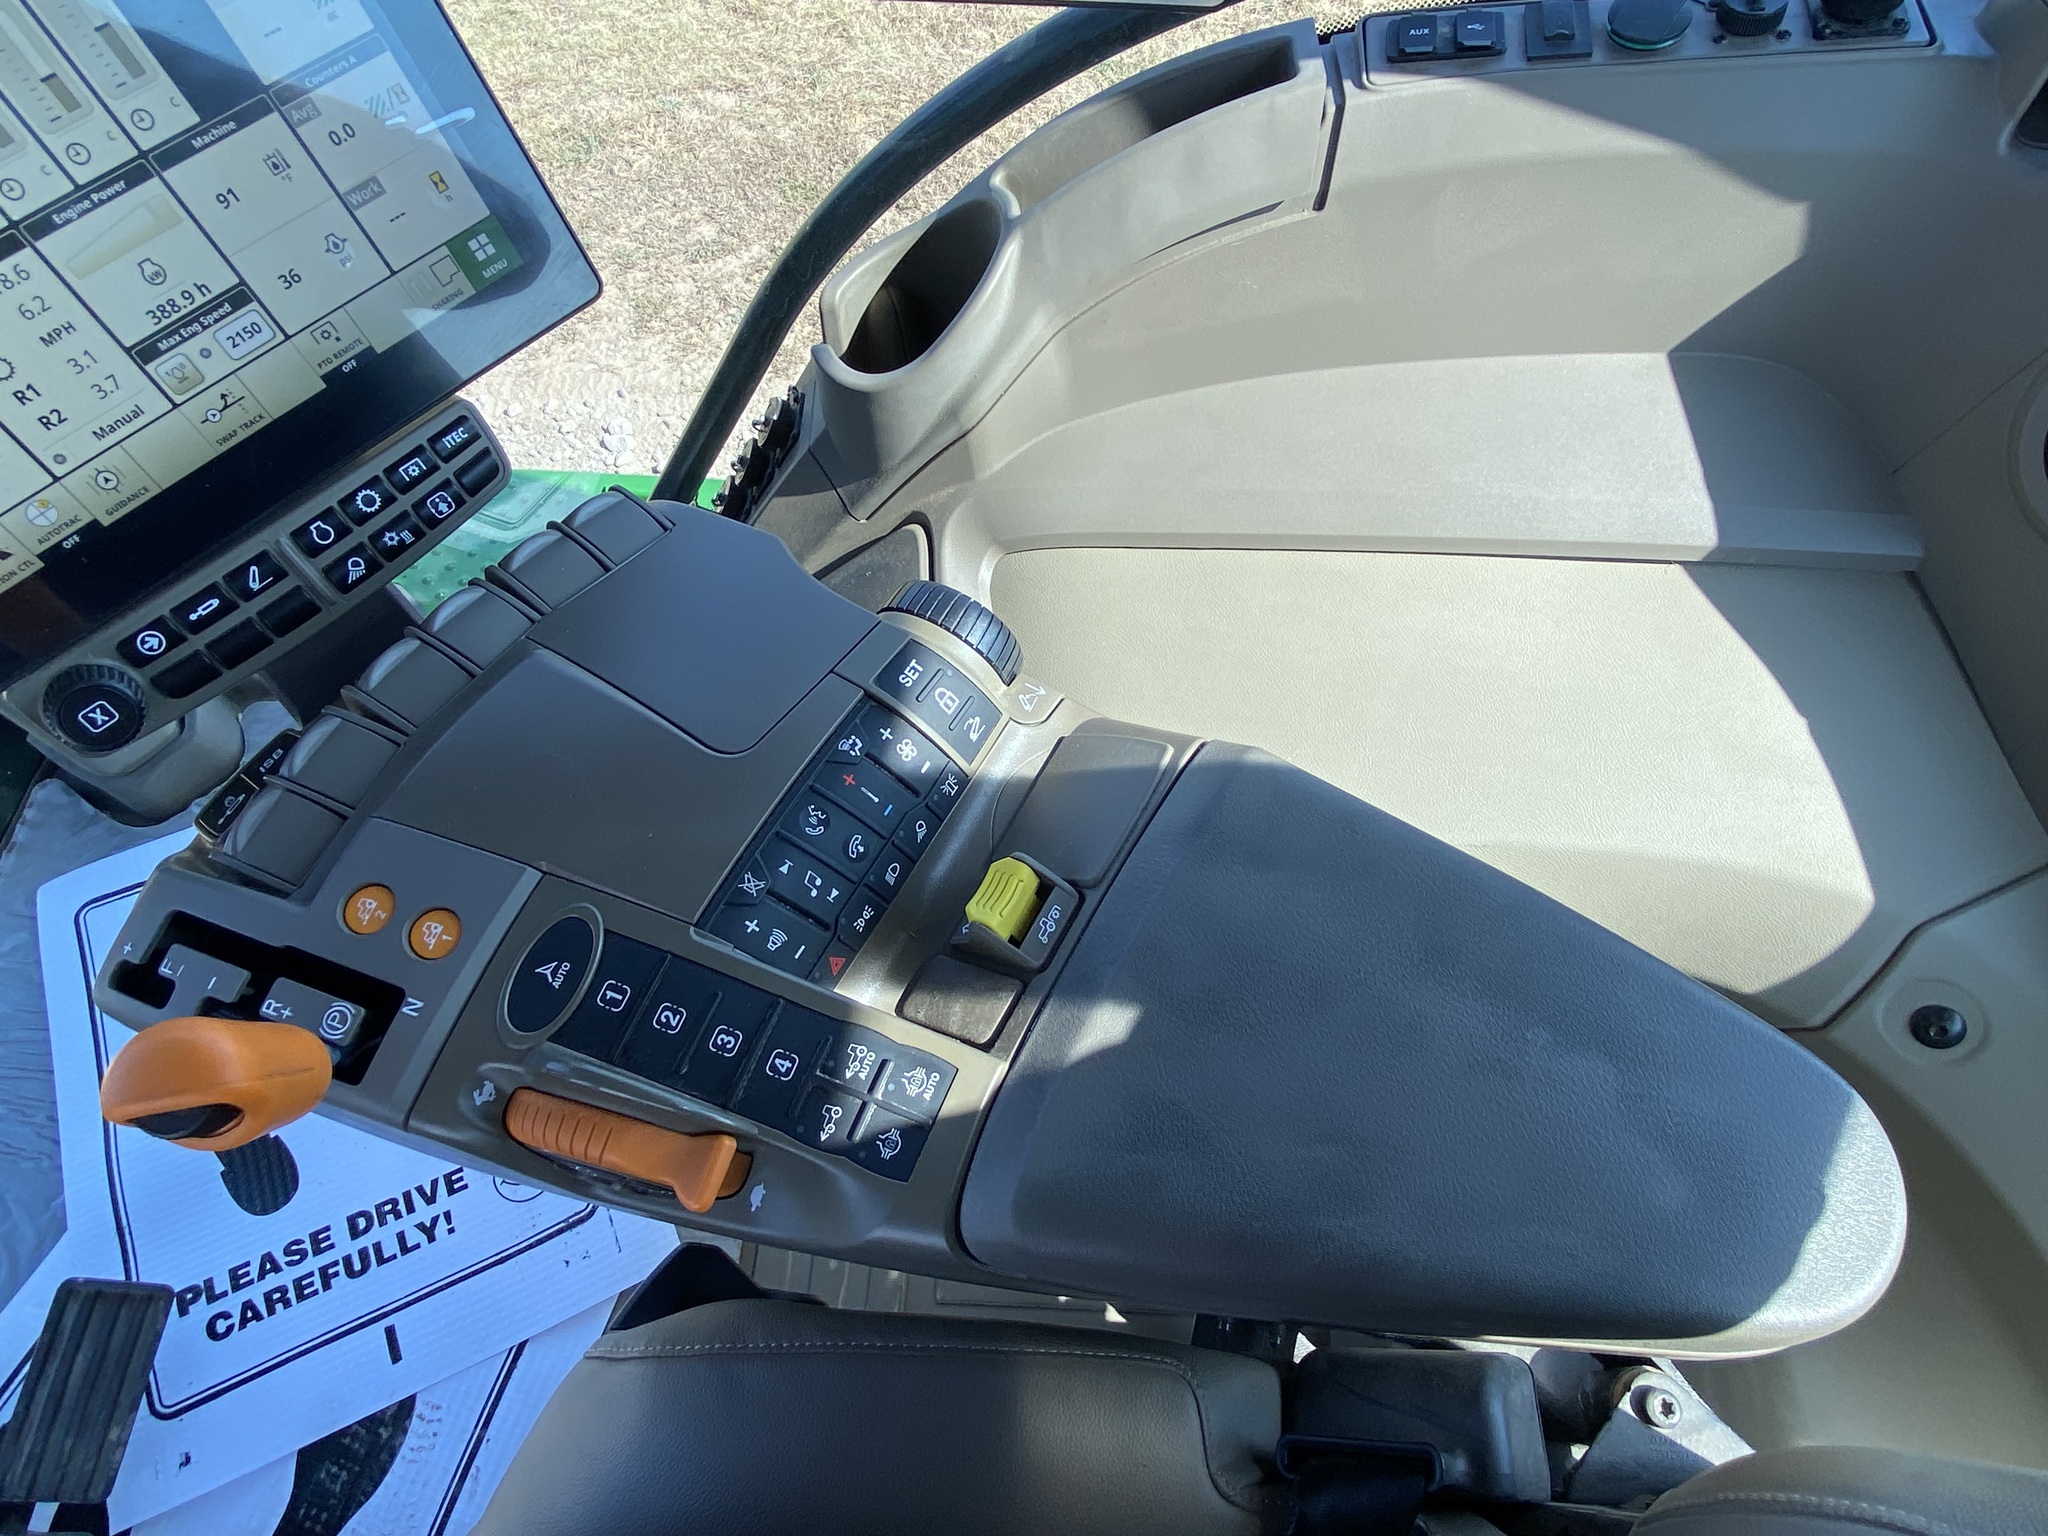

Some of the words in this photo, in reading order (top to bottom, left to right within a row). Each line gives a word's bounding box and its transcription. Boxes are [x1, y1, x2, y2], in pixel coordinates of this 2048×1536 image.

[1409, 27, 1430, 36] AUX
[304, 60, 349, 88] Counters
[348, 54, 358, 64] A
[290, 104, 318, 123] Avg
[191, 120, 237, 149] Machine
[328, 123, 356, 146] 0.0
[52, 199, 93, 225] Engine
[90, 180, 127, 203] Power
[215, 187, 240, 210] 91
[346, 181, 382, 206] Work
[0, 263, 30, 294] 8.6
[277, 268, 302, 290] 36
[482, 258, 508, 279] MENU
[18, 296, 52, 320] 6.2
[145, 290, 196, 326] 388.9
[193, 282, 212, 298] h
[431, 288, 464, 311] SHARING
[39, 320, 77, 348] MPH
[156, 333, 183, 351] Max
[180, 321, 203, 338] Eng
[199, 302, 233, 326] Speed
[226, 322, 262, 349] 2150
[66, 350, 98, 375] 3.1
[317, 357, 334, 370] PTO
[333, 338, 364, 360] REMOTE
[341, 359, 358, 373] OFF
[12, 383, 42, 406] R1
[90, 374, 119, 400] 3.7
[37, 408, 69, 431] R2
[91, 404, 146, 441] Manual
[216, 429, 238, 447] SWAP
[238, 413, 266, 431] TRACK
[105, 486, 150, 516] GUIDANCE
[37, 514, 82, 546] AUTOTRAC
[62, 534, 81, 549] OFF
[17, 559, 36, 571] CTL
[898, 658, 924, 688] SET
[551, 961, 571, 990] AUTO
[402, 997, 424, 1017] N
[604, 989, 624, 1001] 1
[660, 1009, 681, 1027] 2
[716, 1032, 736, 1050] 3
[773, 1055, 793, 1074] 4
[858, 1051, 876, 1081] AUTO
[922, 1072, 941, 1101] AUTO
[175, 1224, 336, 1318] PLEASE
[346, 1166, 470, 1241] DRIVE
[205, 1209, 456, 1342] CAREFULLY!
